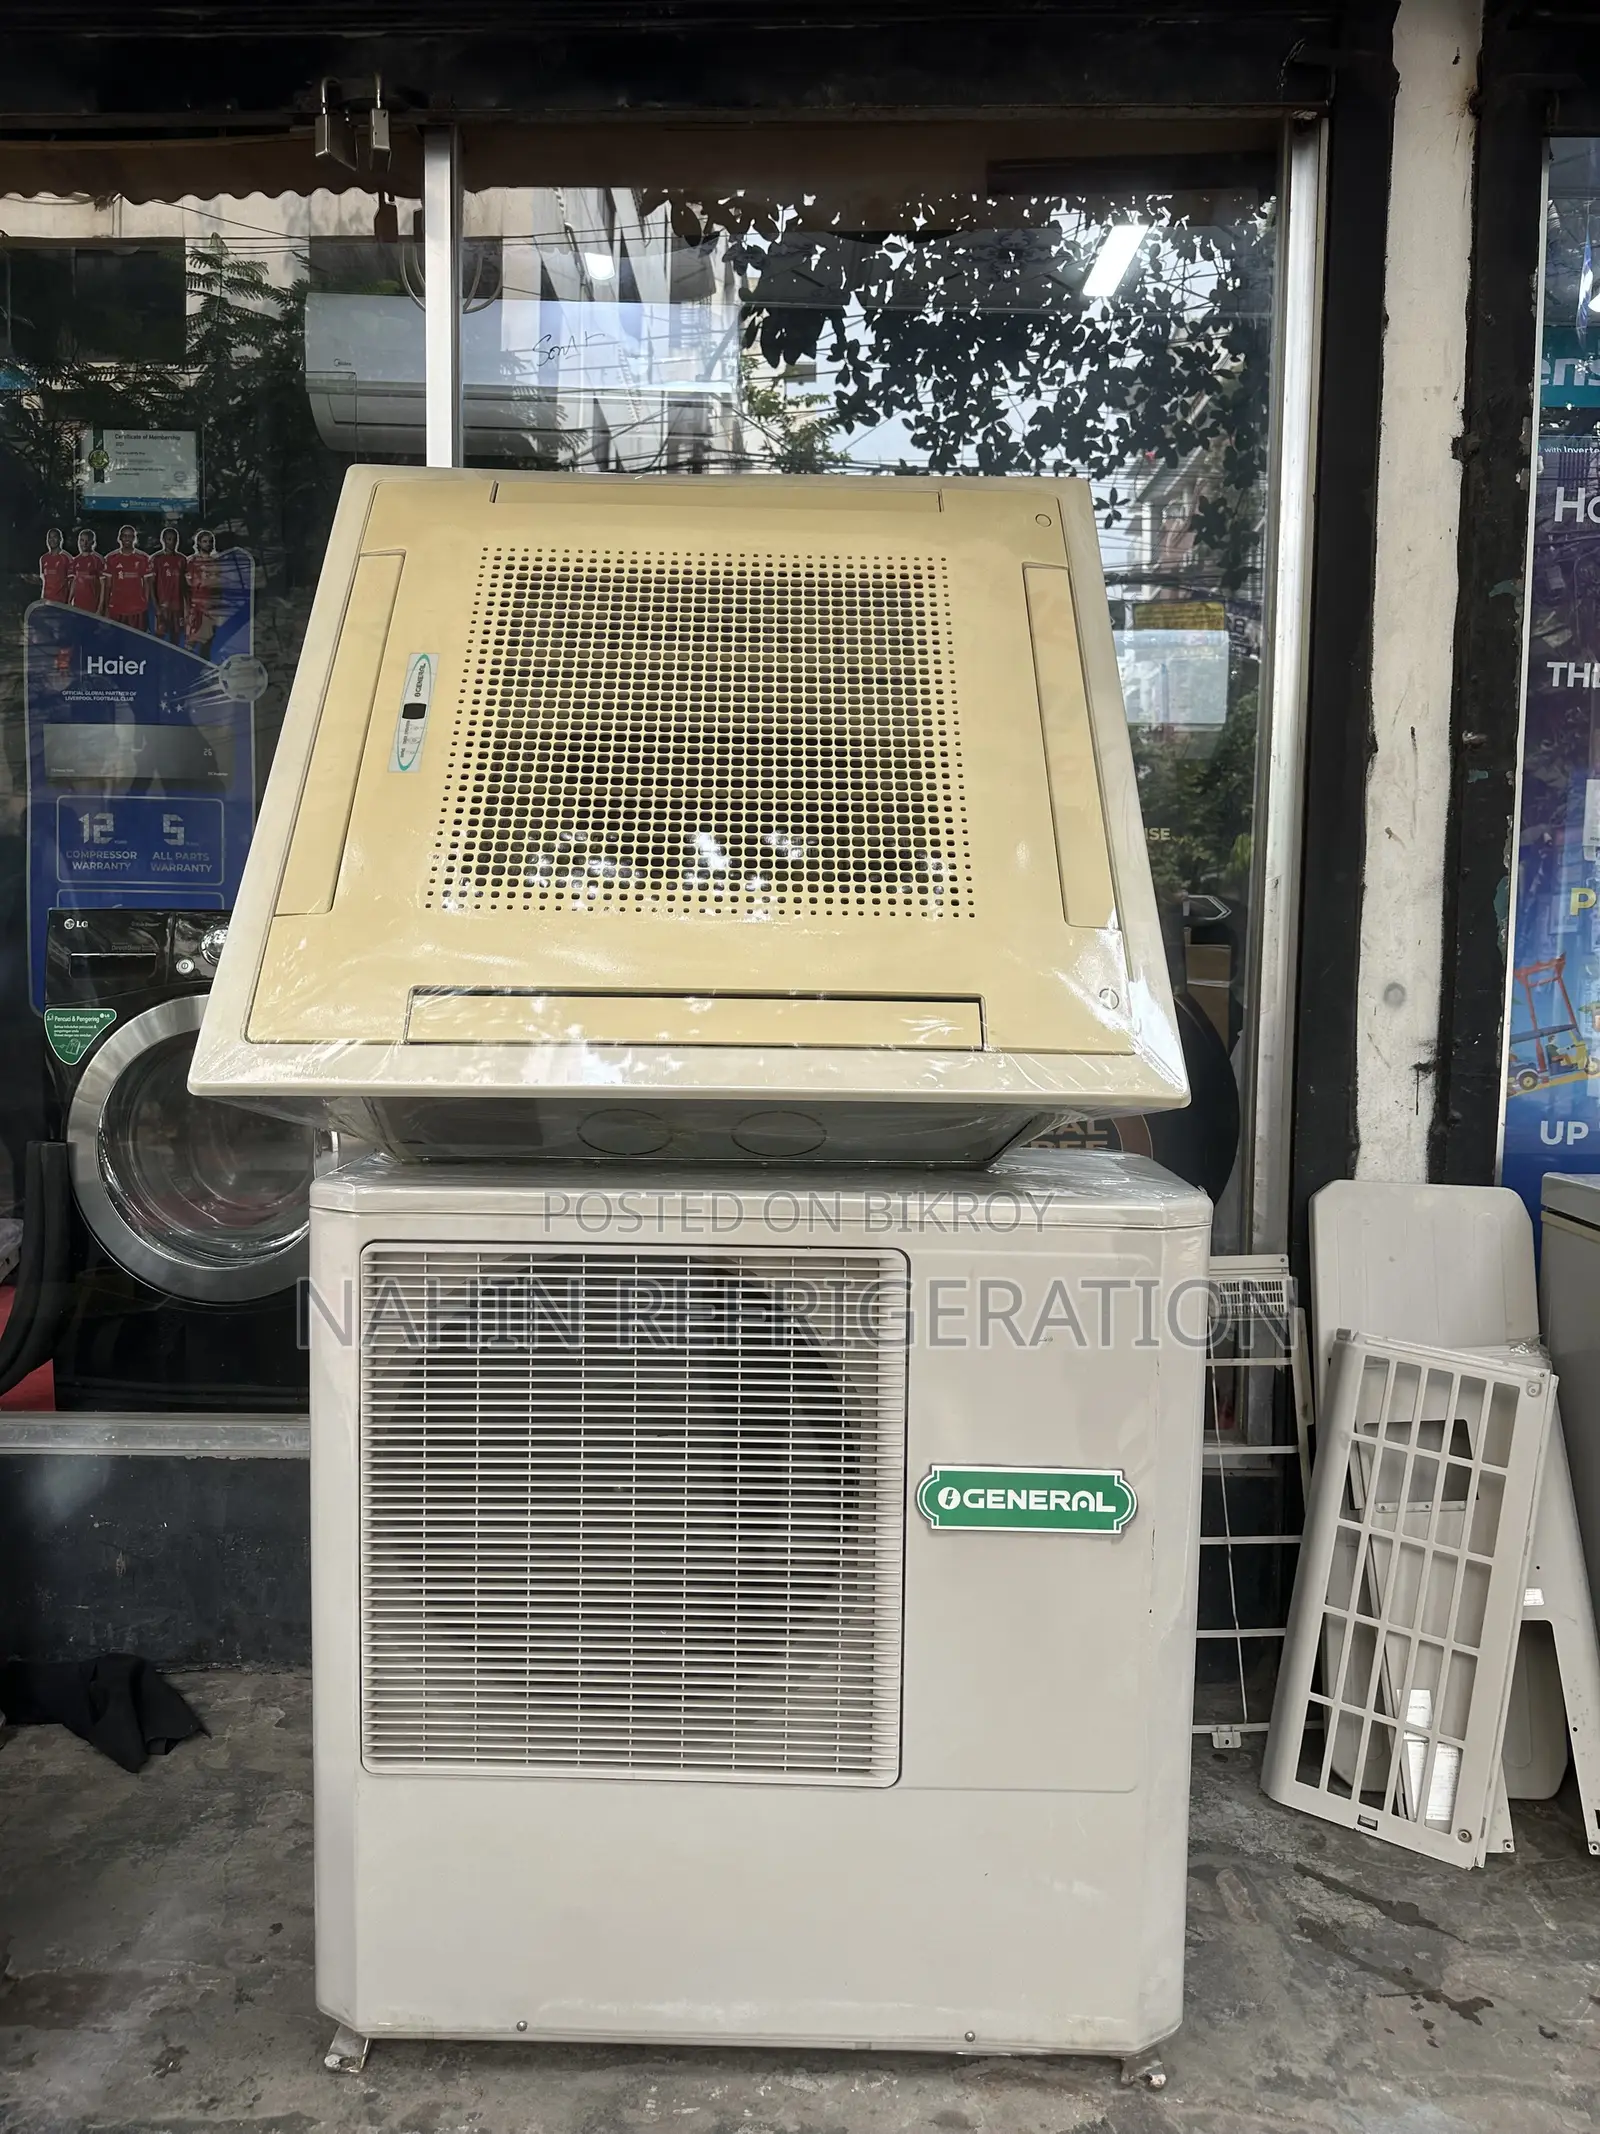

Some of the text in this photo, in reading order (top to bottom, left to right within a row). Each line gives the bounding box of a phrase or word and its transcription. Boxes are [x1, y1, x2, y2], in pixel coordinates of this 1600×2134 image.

[87, 655, 147, 675] Haier
[78, 812, 114, 844] 12
[162, 813, 185, 846] 5
[66, 850, 138, 860] COMPRESSOR
[152, 851, 210, 862] ALL PARTS
[72, 861, 132, 871] WARRANTY
[150, 863, 213, 873] WARRANTY
[76, 920, 89, 929] LG
[1540, 1120, 1589, 1146] UP
